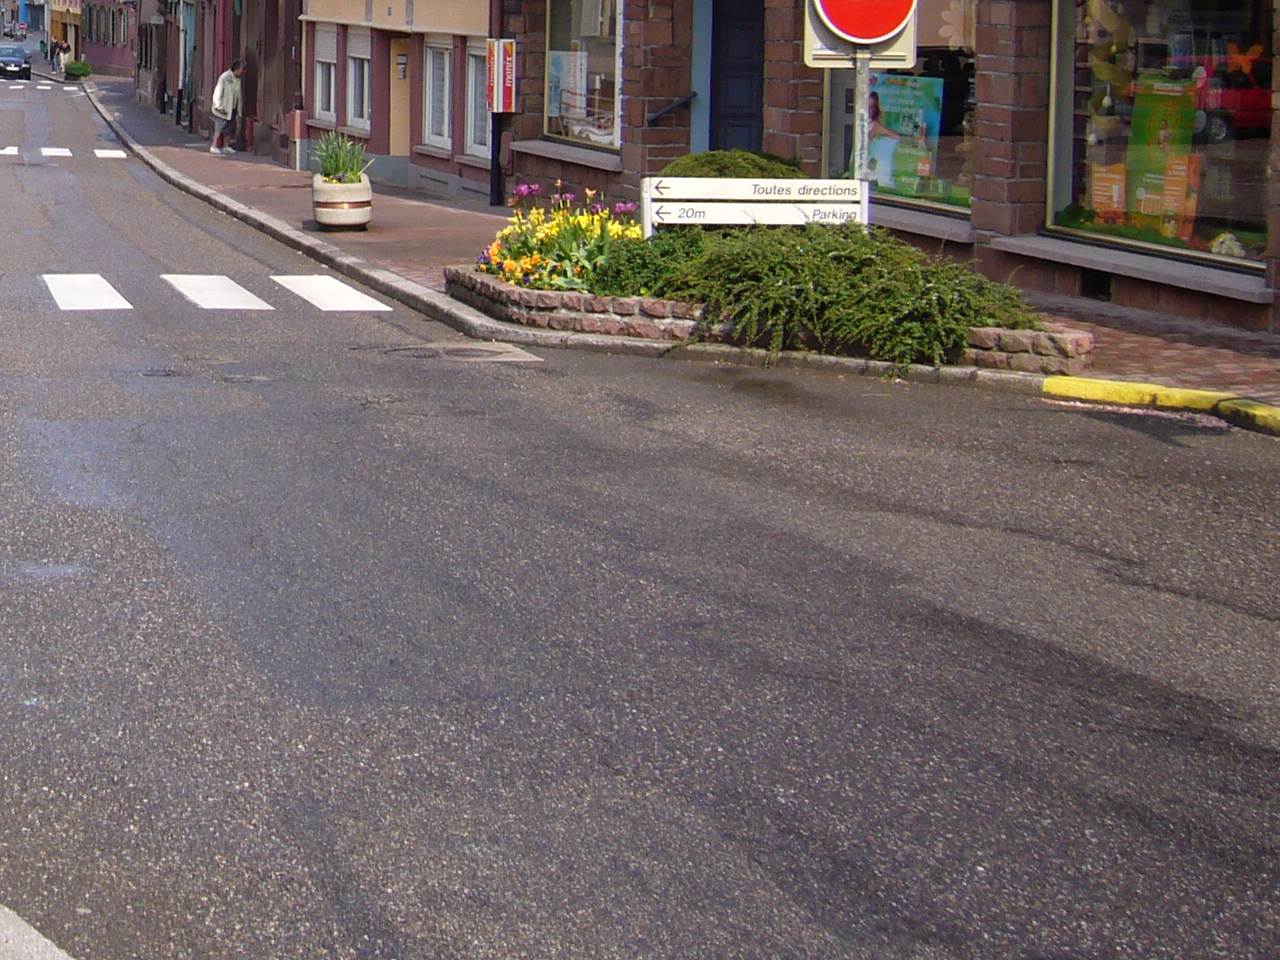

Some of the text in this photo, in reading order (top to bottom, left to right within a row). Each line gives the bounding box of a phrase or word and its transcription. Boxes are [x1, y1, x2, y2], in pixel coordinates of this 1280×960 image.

[751, 183, 858, 197] Toutes directions
[677, 207, 858, 222] 20m Parking
